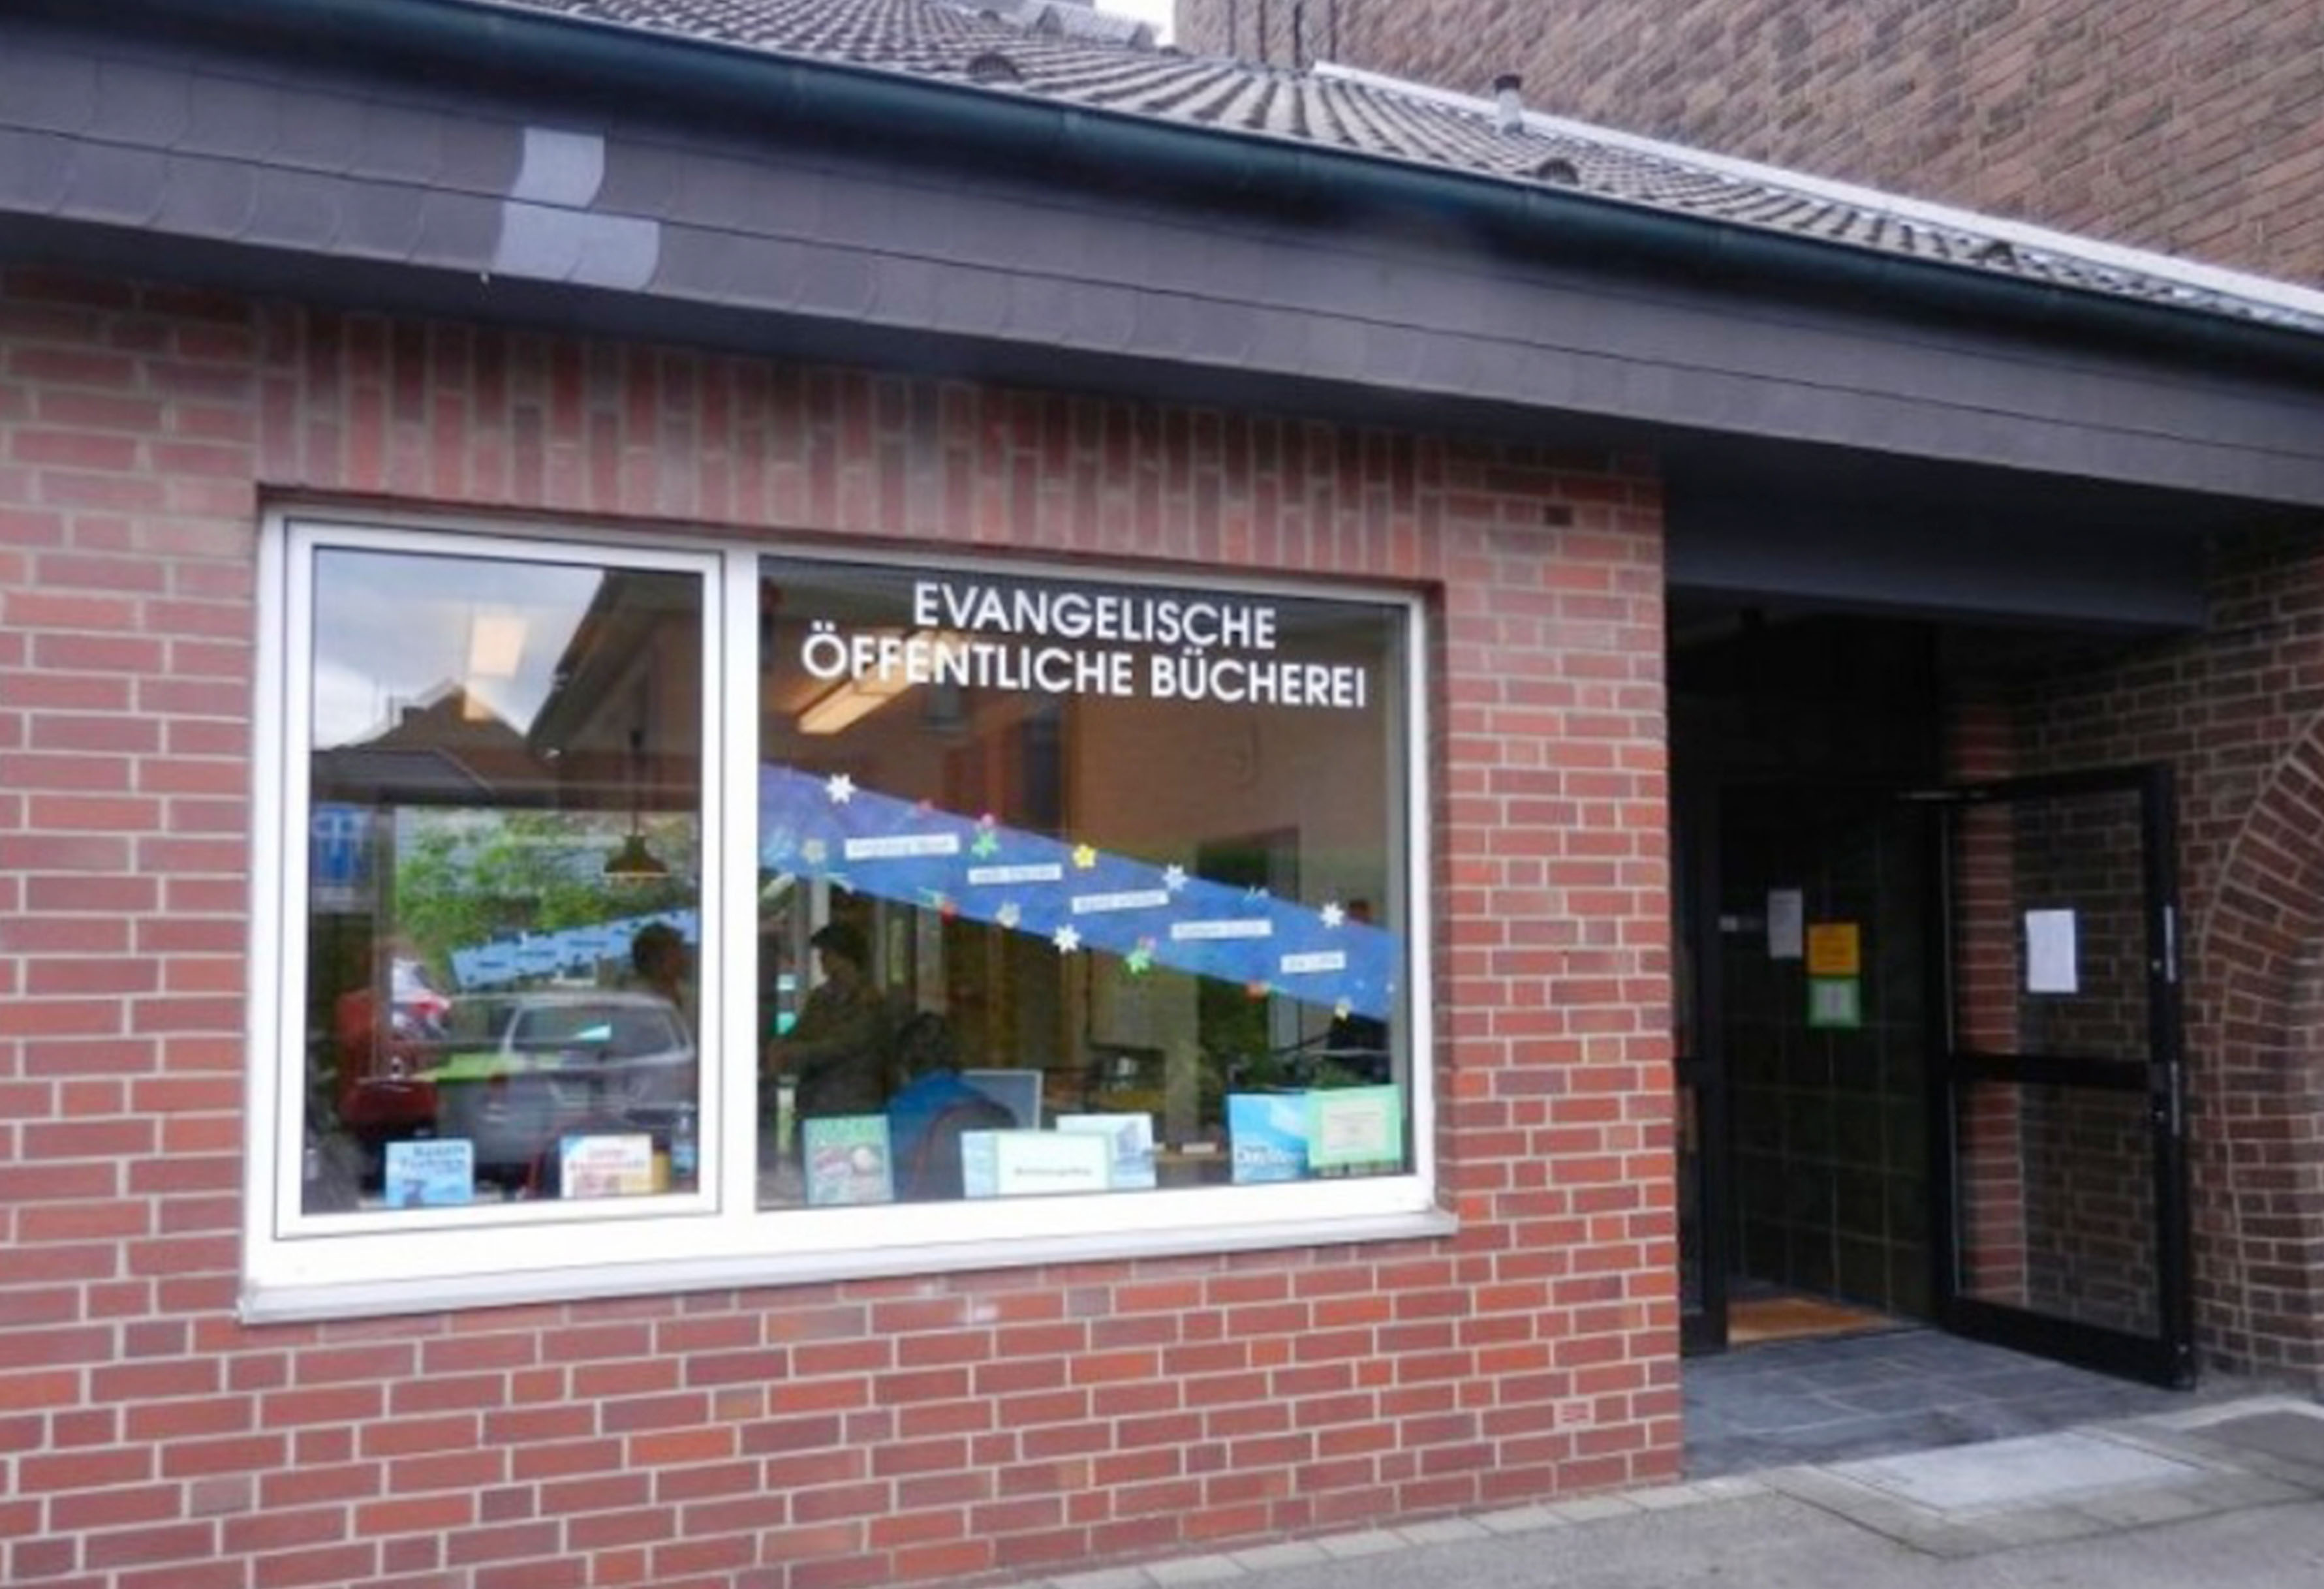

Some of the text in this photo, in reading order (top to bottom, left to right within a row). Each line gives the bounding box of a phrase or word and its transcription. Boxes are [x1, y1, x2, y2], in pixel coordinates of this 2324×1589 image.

[914, 582, 1277, 649] EVANGELISCHE
[802, 621, 1367, 707] ÖFFENTLICHE BÜCHEREI
